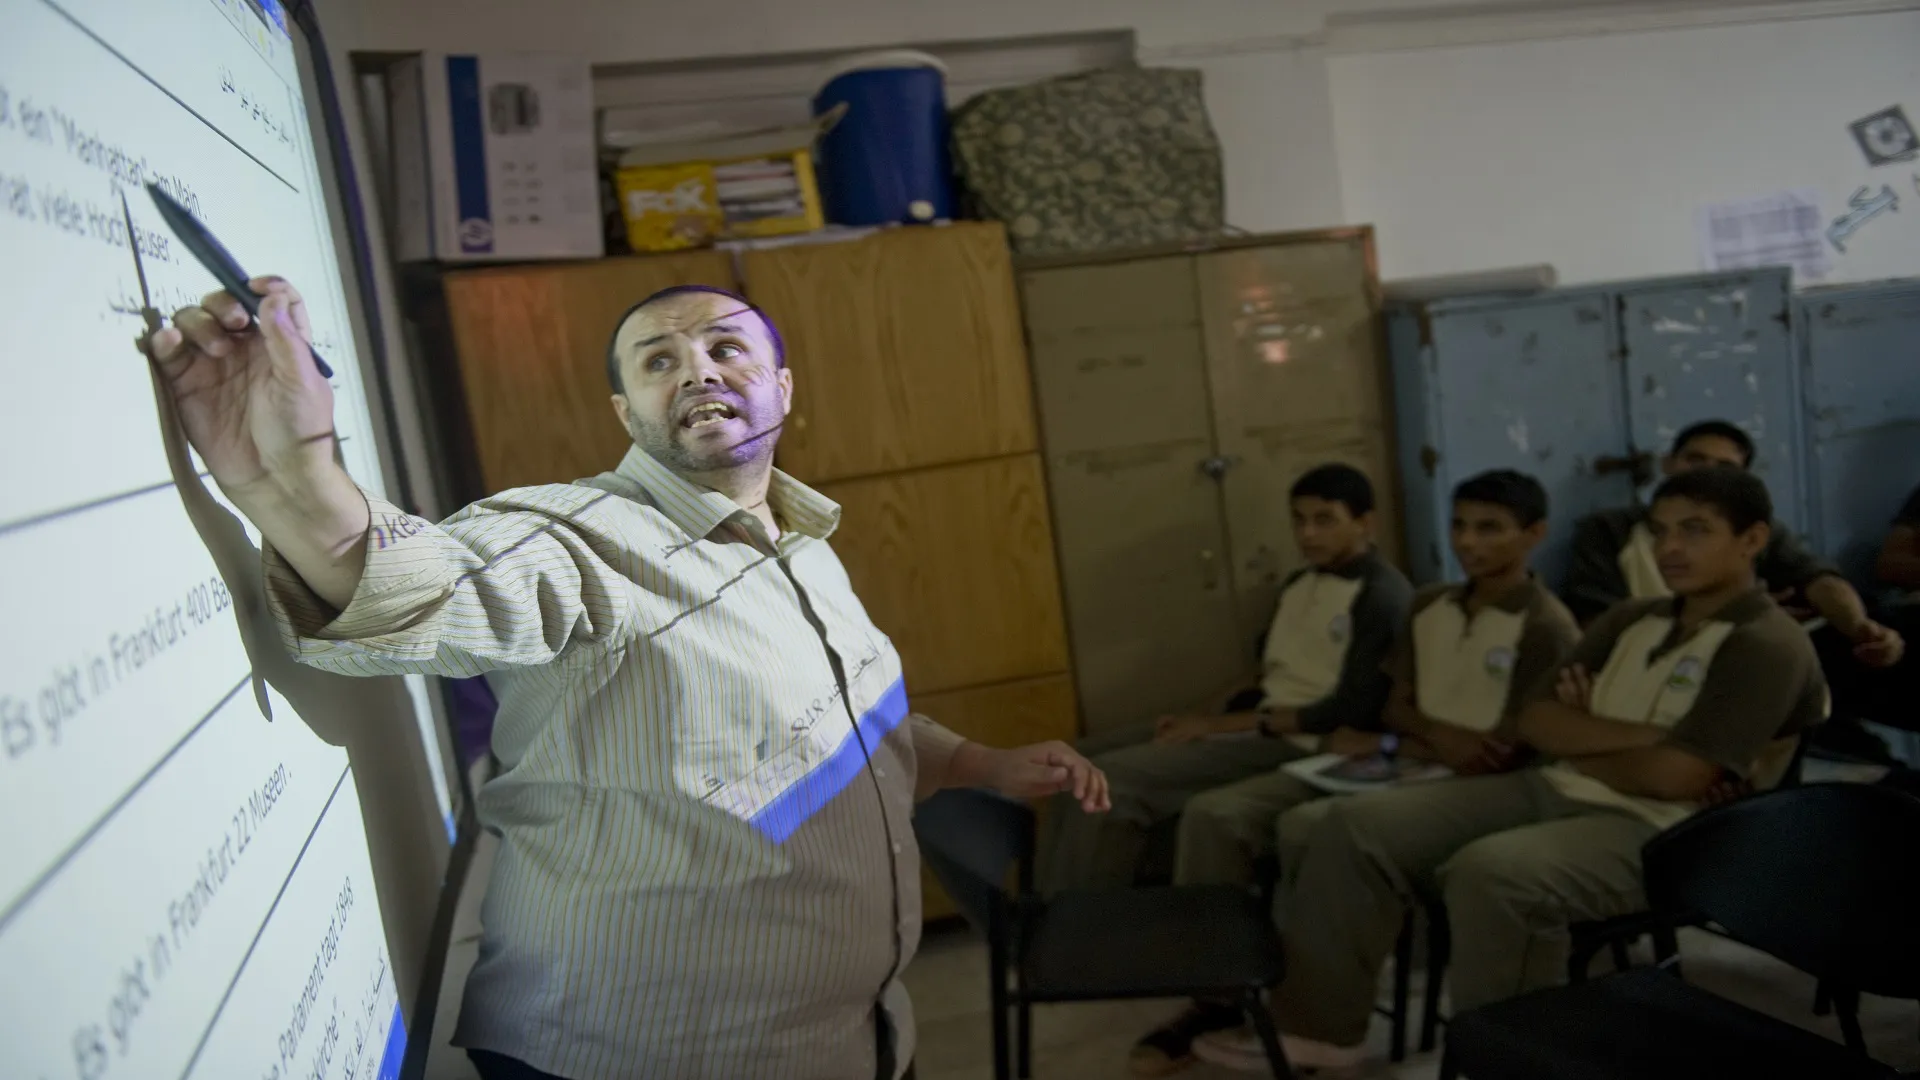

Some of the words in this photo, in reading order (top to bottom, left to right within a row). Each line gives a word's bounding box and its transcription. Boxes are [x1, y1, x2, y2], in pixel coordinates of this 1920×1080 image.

[85, 199, 171, 263] Hochäuser
[1, 694, 37, 760] Es
[37, 664, 87, 748] gibt
[109, 599, 187, 683] Frankfurt
[186, 582, 212, 629] 400
[108, 954, 152, 1059] gibt
[167, 830, 236, 951] Frankfurt
[232, 806, 251, 854] 22
[248, 762, 287, 832] Museen
[278, 952, 325, 1076] Parlament
[319, 912, 339, 969] tagt
[334, 875, 354, 932] 1848
